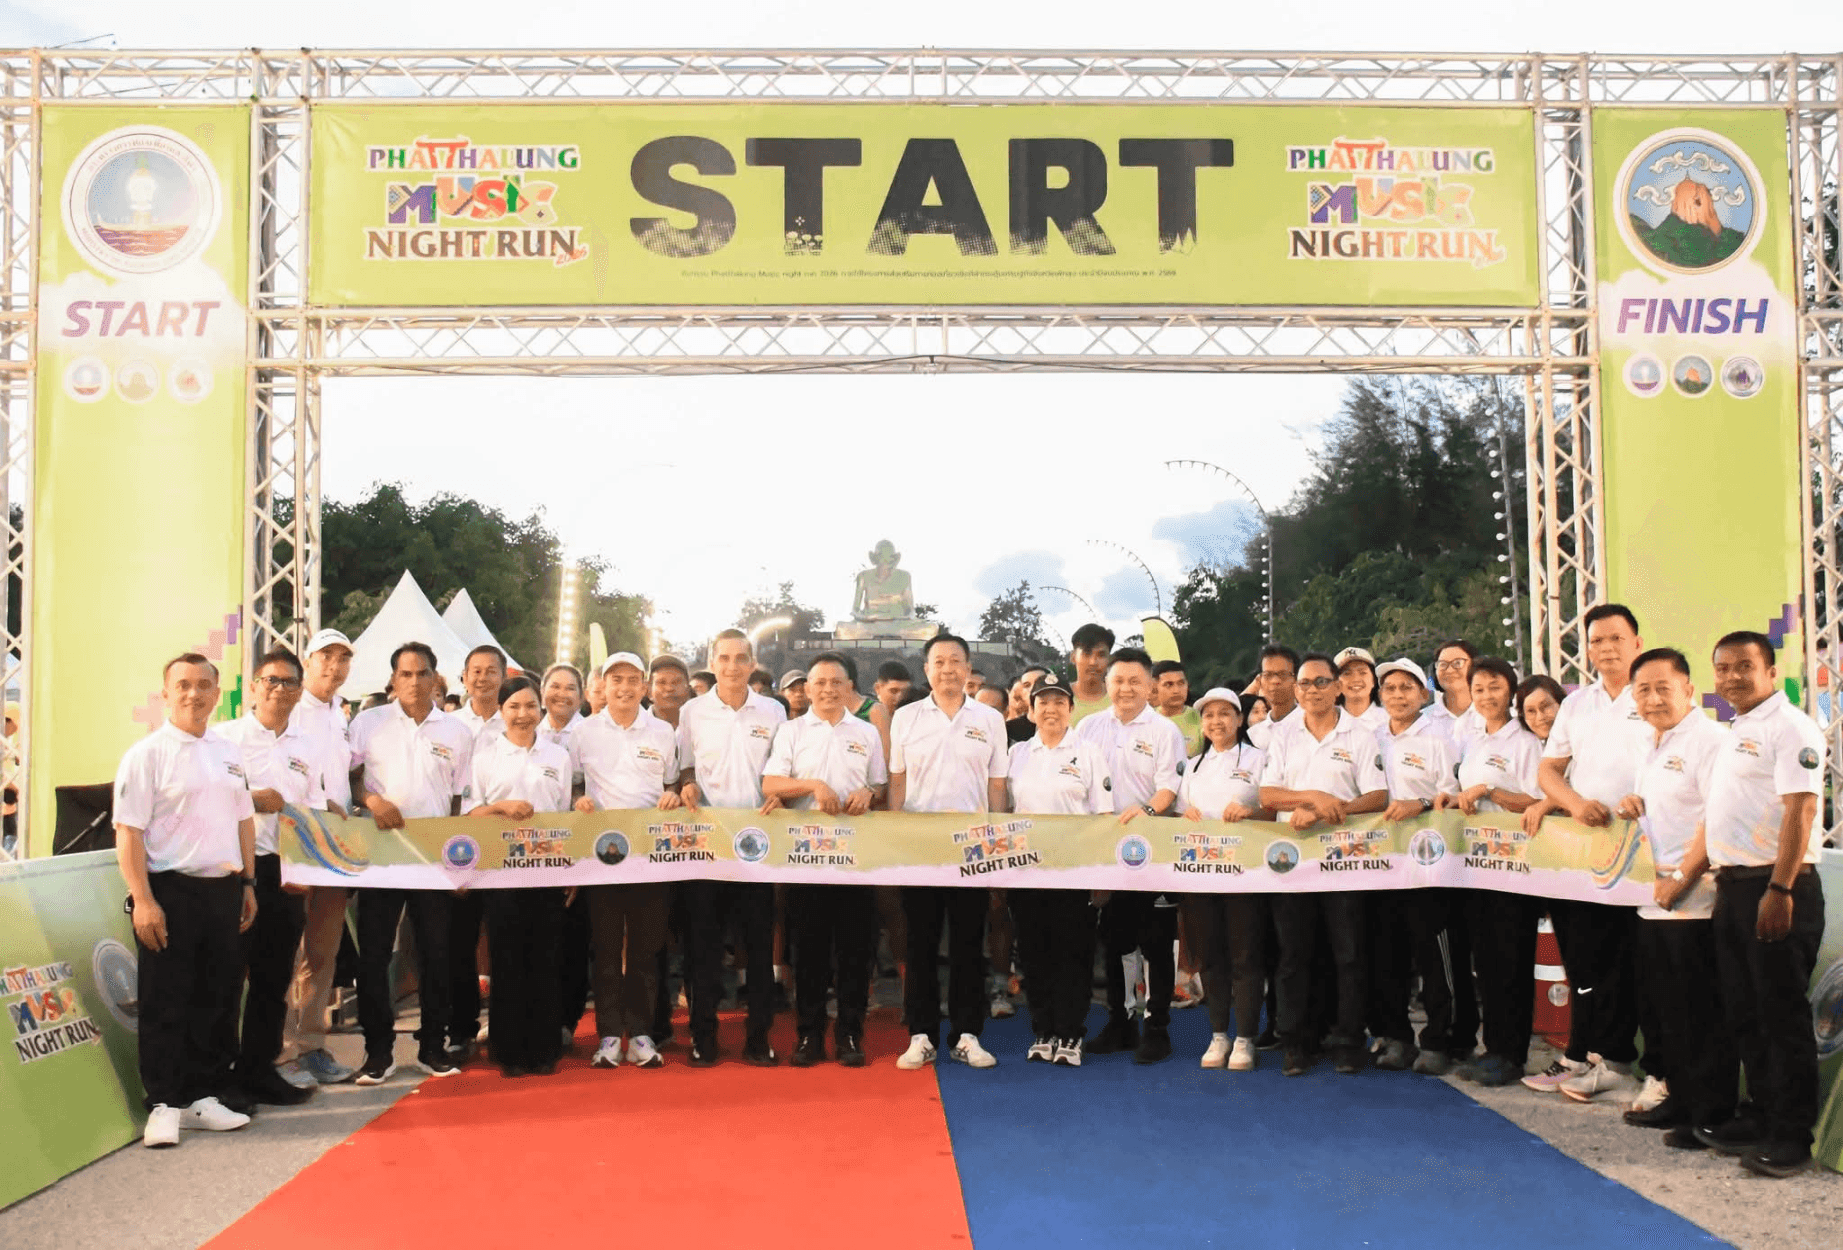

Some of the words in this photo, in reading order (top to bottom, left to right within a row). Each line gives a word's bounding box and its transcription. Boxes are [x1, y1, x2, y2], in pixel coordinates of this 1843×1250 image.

[369, 142, 579, 169] PHATTHALUNG
[629, 135, 1234, 258] START
[368, 230, 487, 258] NIGHT
[497, 230, 575, 258] RUN
[1292, 230, 1407, 258] NIGHT
[1416, 231, 1494, 260] RUN
[61, 300, 220, 338] START
[1617, 297, 1769, 334] FINISH
[788, 825, 855, 836] PHATTHUNG
[953, 820, 1033, 843] PHATTHAUNG
[1174, 833, 1242, 845] PHATTHAUNG
[1319, 831, 1388, 842] PHATTHAUNG
[503, 858, 542, 868] NIGHT
[544, 857, 572, 867] RUN
[649, 852, 687, 863] NIGHT
[689, 851, 715, 861] RUN
[787, 854, 826, 865] NIGHT
[828, 855, 854, 865] RUN
[959, 858, 1004, 878] NIGHT
[1007, 851, 1040, 868] RUN
[1319, 860, 1360, 872] NIGHT
[1362, 859, 1390, 870] RUN
[1464, 857, 1504, 870] NIGHT
[1506, 861, 1530, 873] RUN
[1173, 862, 1213, 873] NIGHT
[1215, 863, 1241, 874] RUN
[15, 1027, 66, 1063] NIGHT
[65, 1018, 101, 1045] RUN
